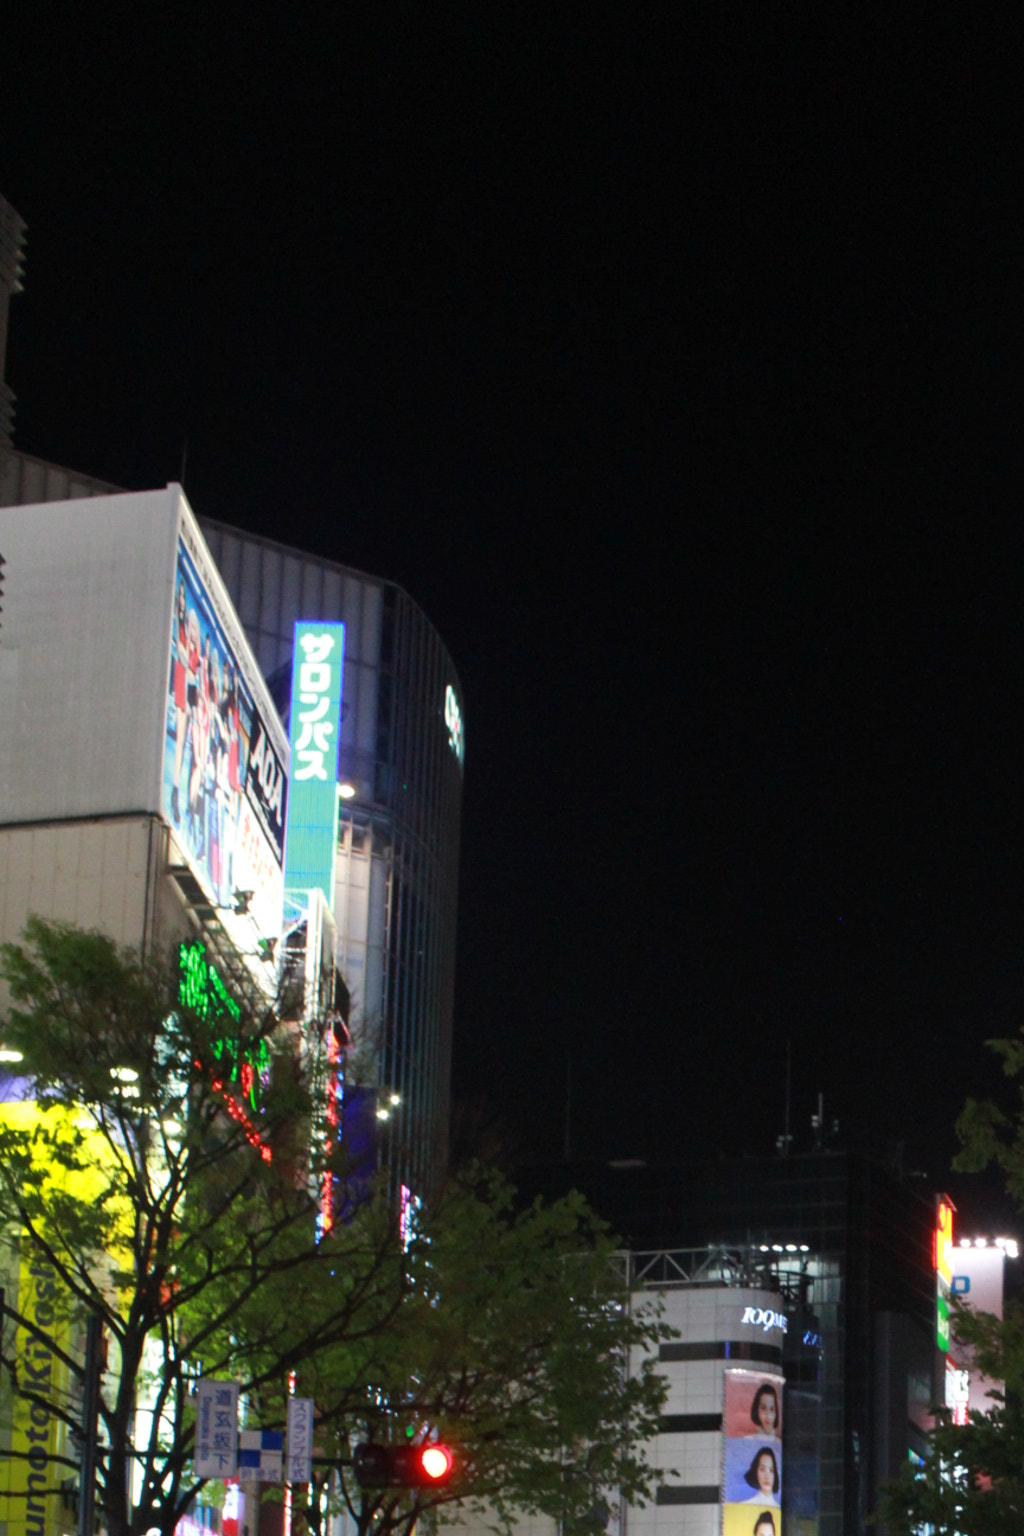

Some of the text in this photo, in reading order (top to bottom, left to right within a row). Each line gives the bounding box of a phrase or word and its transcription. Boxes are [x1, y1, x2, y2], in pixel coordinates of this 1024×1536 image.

[295, 633, 335, 781] サロンパス
[250, 723, 283, 826] AOA
